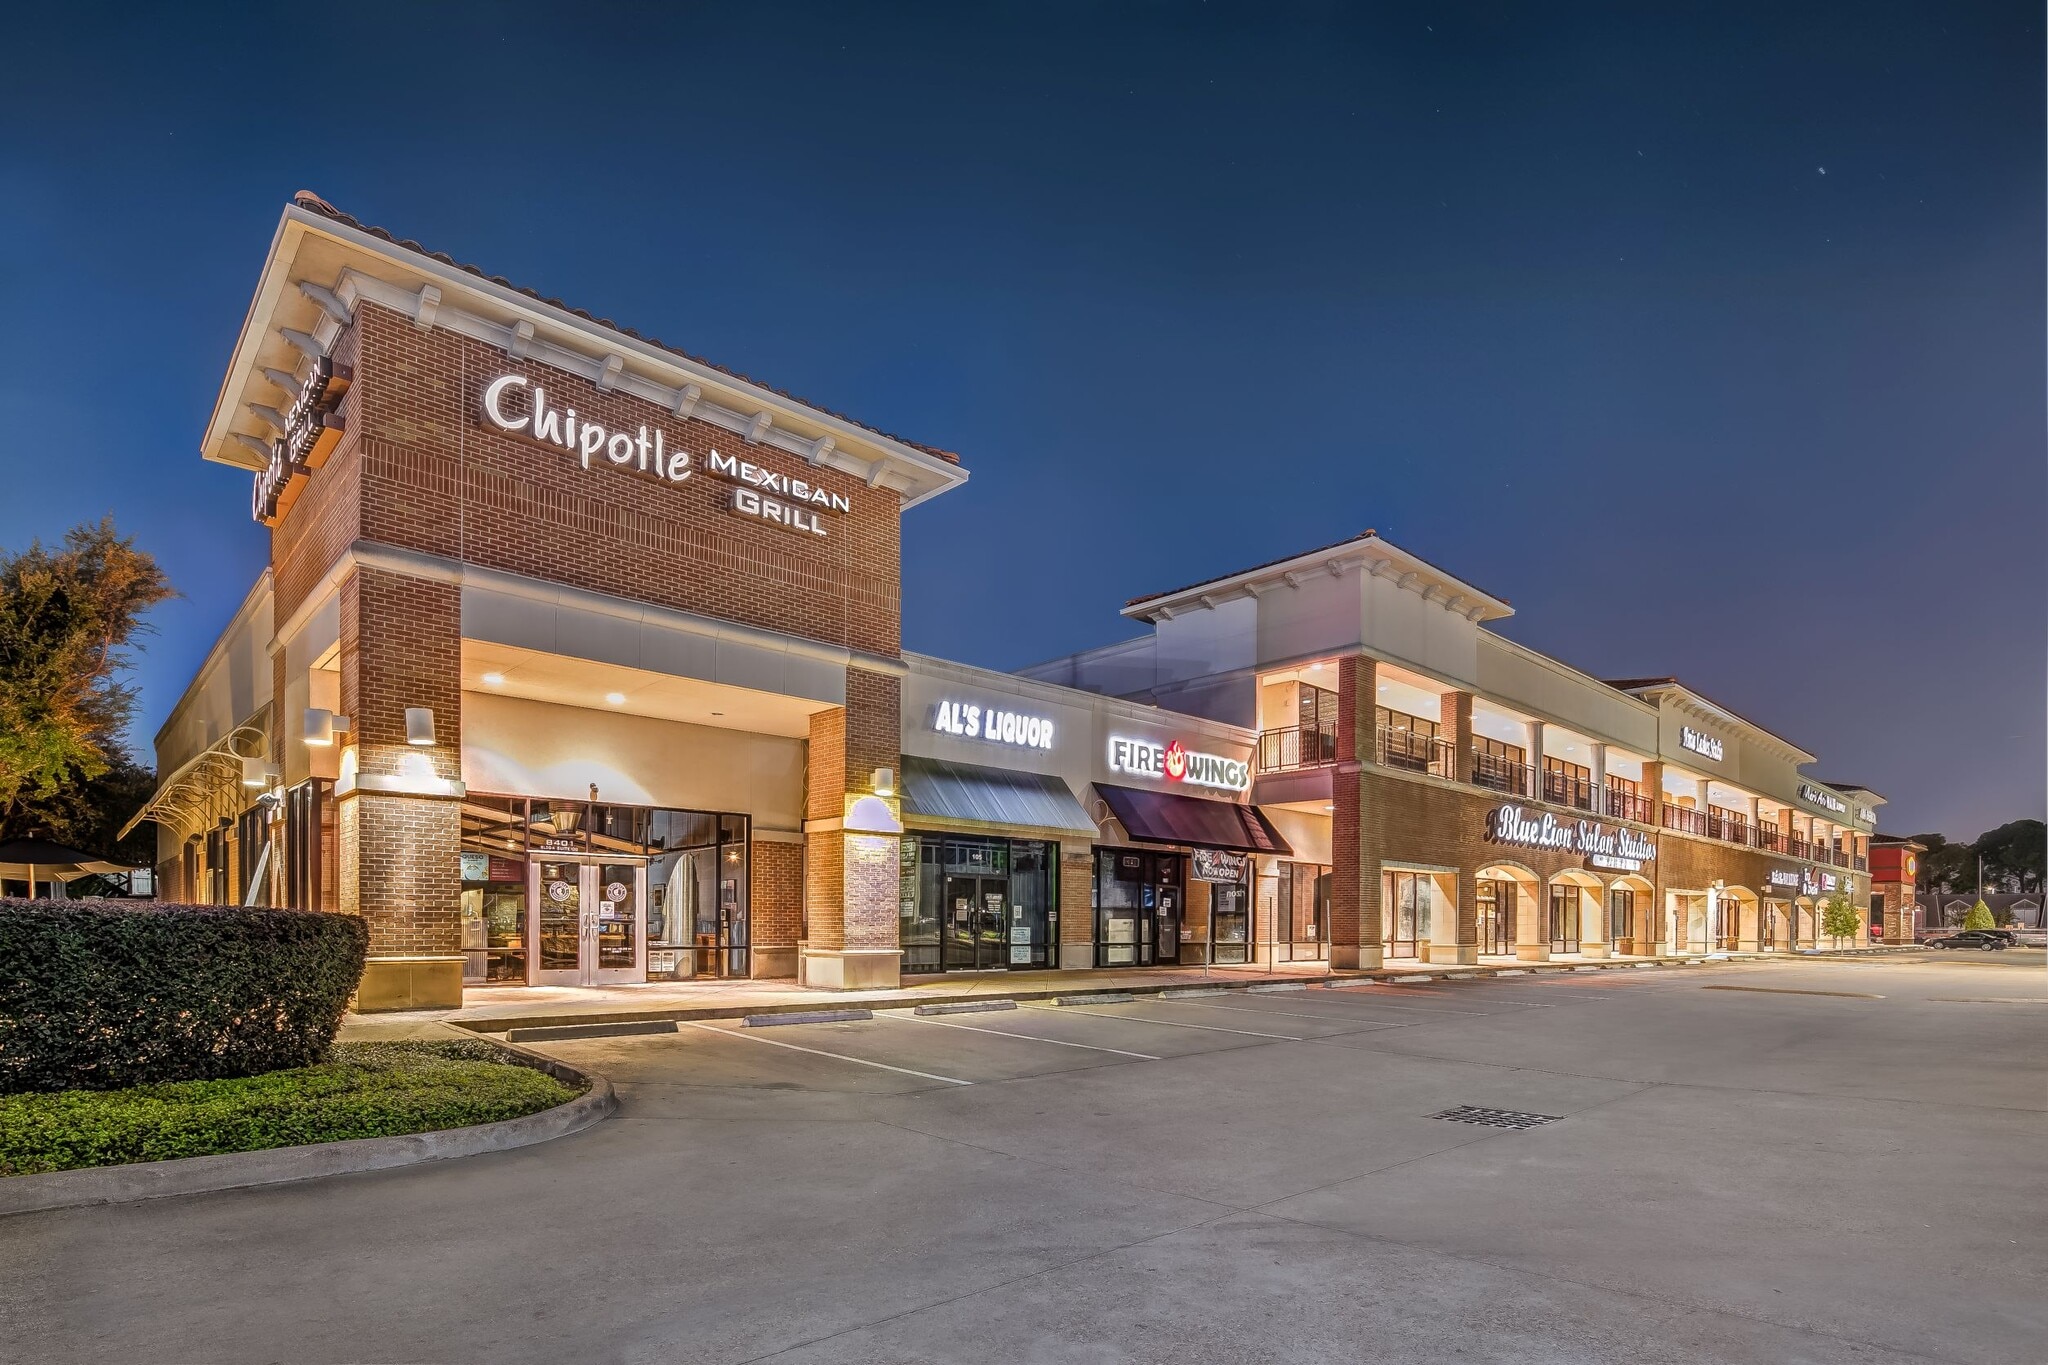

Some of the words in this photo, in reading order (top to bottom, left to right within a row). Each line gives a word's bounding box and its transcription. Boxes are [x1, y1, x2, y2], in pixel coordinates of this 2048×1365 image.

[485, 375, 692, 480] Chipotle
[710, 448, 850, 513] MEXICAN
[736, 487, 827, 536] GRILL
[935, 700, 981, 737] AL'S
[985, 709, 1054, 749] LIQUOR
[1114, 740, 1165, 774] FIRE
[1186, 754, 1248, 788] WINGS
[546, 839, 574, 847] 8401
[1497, 804, 1539, 842] Blue
[1539, 812, 1572, 848] Lion
[1577, 819, 1614, 854] Salon
[1617, 827, 1657, 861] Studios
[1195, 849, 1213, 863] FIRE
[1220, 853, 1246, 868] WINGS
[1219, 868, 1239, 878] OPEN
